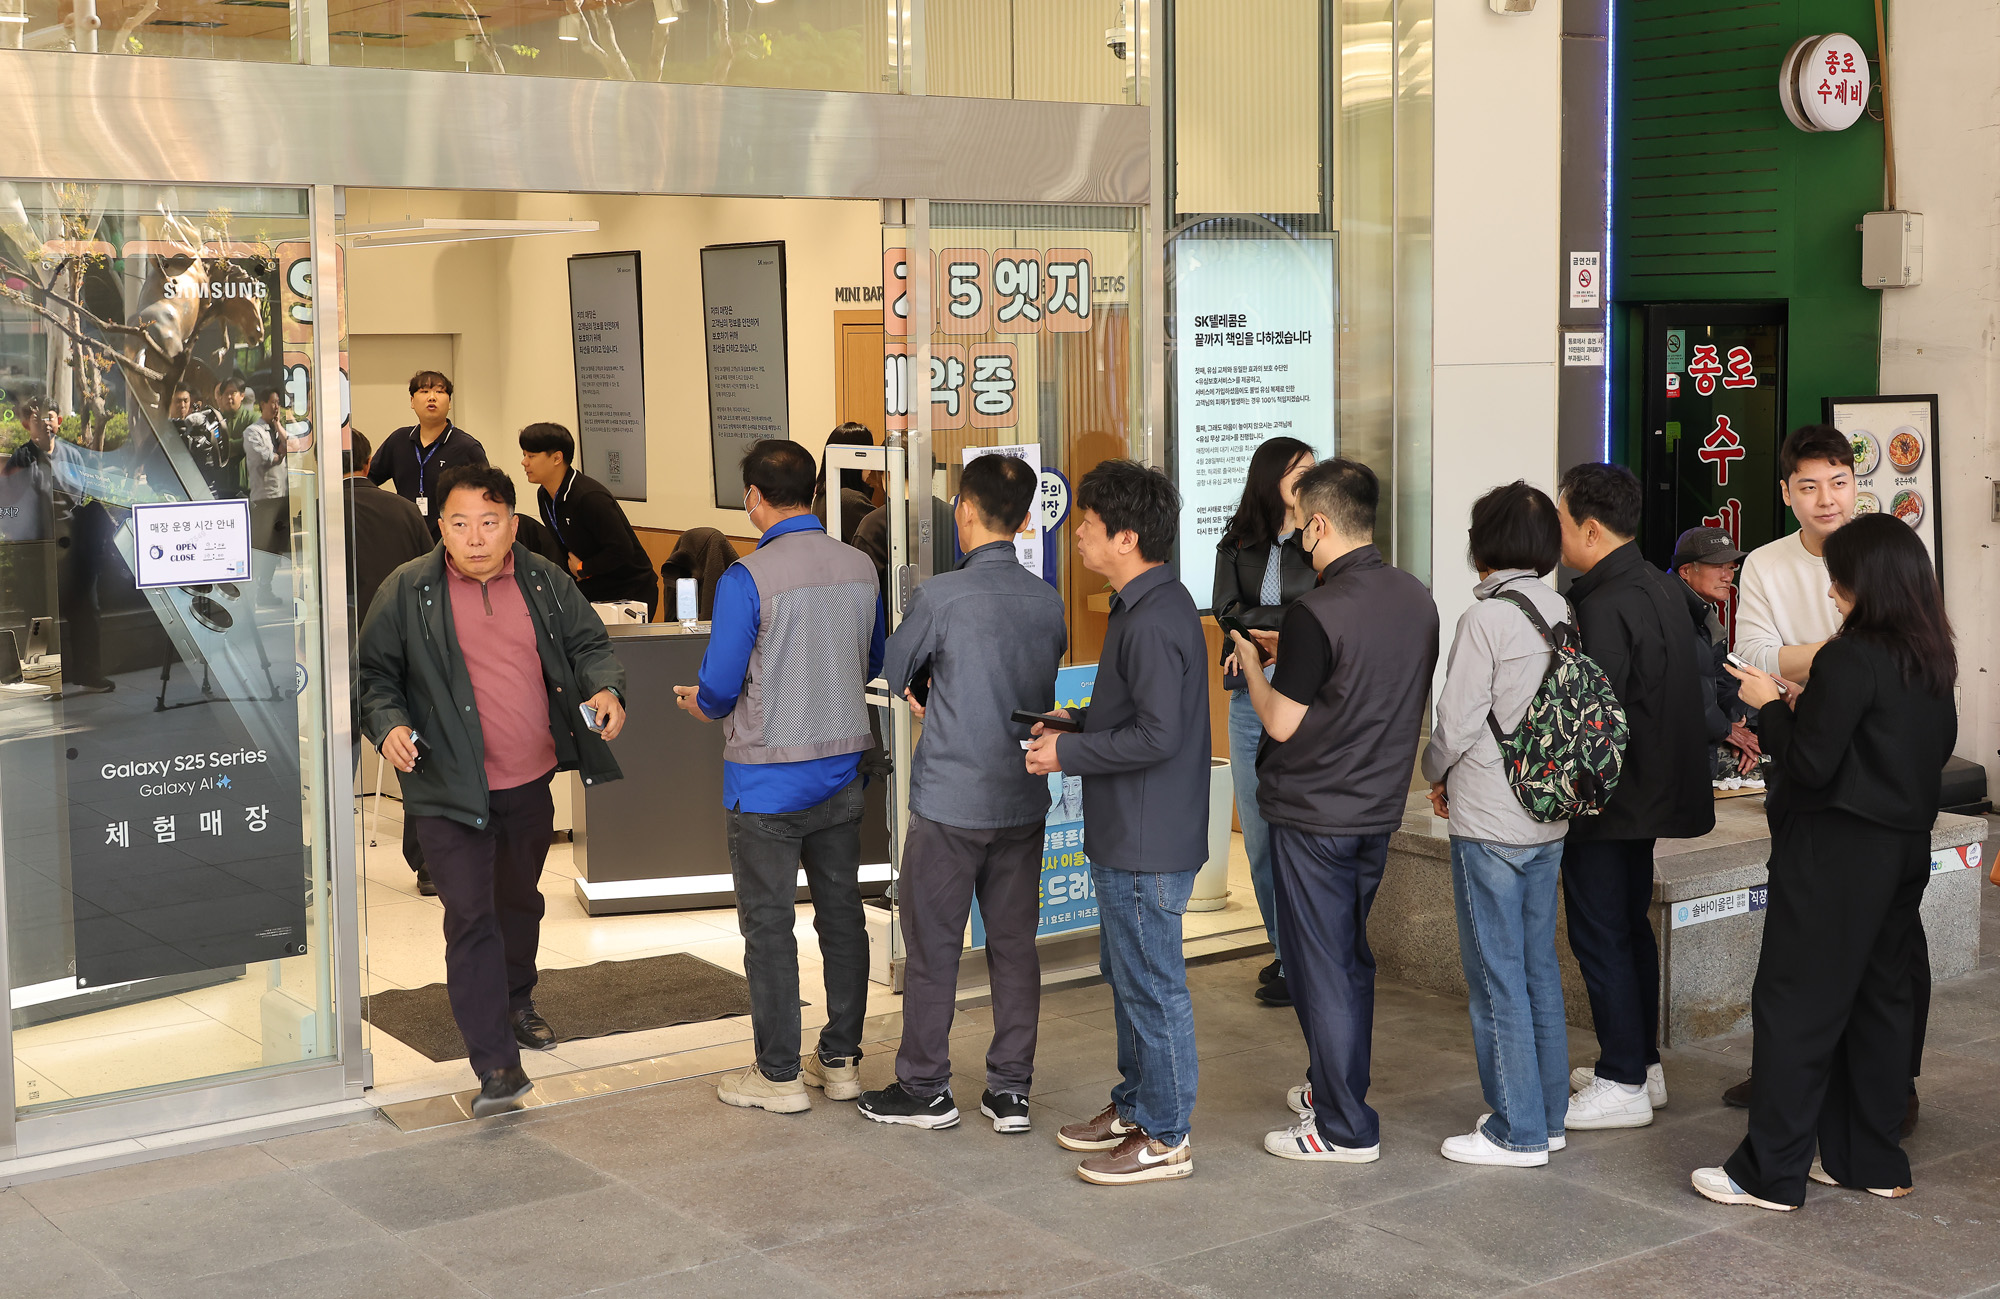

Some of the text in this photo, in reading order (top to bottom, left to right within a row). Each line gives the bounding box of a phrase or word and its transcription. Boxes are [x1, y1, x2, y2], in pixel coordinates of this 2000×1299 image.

[1825, 50, 1856, 75] 종로
[1817, 78, 1863, 106] 수제비
[1572, 257, 1597, 266] 금연건물
[163, 281, 267, 299] SAMSUNG
[1092, 276, 1126, 292] LERS
[835, 286, 883, 302] MINI BAR
[1194, 313, 1248, 329] SK텔레콤은
[1195, 330, 1312, 347] 끝까지 책임을 다하겠습니다
[1207, 366, 1217, 374] 유심
[1218, 366, 1232, 374] 교체와
[1248, 365, 1263, 373] 효과의
[1263, 364, 1273, 372] 보호
[1274, 364, 1288, 372] 수단인
[1688, 344, 1757, 396] 종로
[1260, 386, 1270, 394] 유심
[1286, 385, 1295, 393] 인한
[1195, 399, 1215, 407] 고객님의
[1215, 398, 1231, 406] 피해가
[1207, 424, 1222, 432] 그래도
[1223, 423, 1237, 431] 마음이
[149, 519, 235, 533] 매장 운영 시간 안내
[176, 543, 197, 551] OPEN
[170, 554, 196, 562] CLOSE
[101, 747, 268, 780] Galaxy S25 Series
[139, 777, 214, 797] Galaxy AI
[1749, 889, 1768, 906] 직장
[1050, 912, 1072, 925] 효도폰
[1077, 907, 1099, 919] 키즈폰
